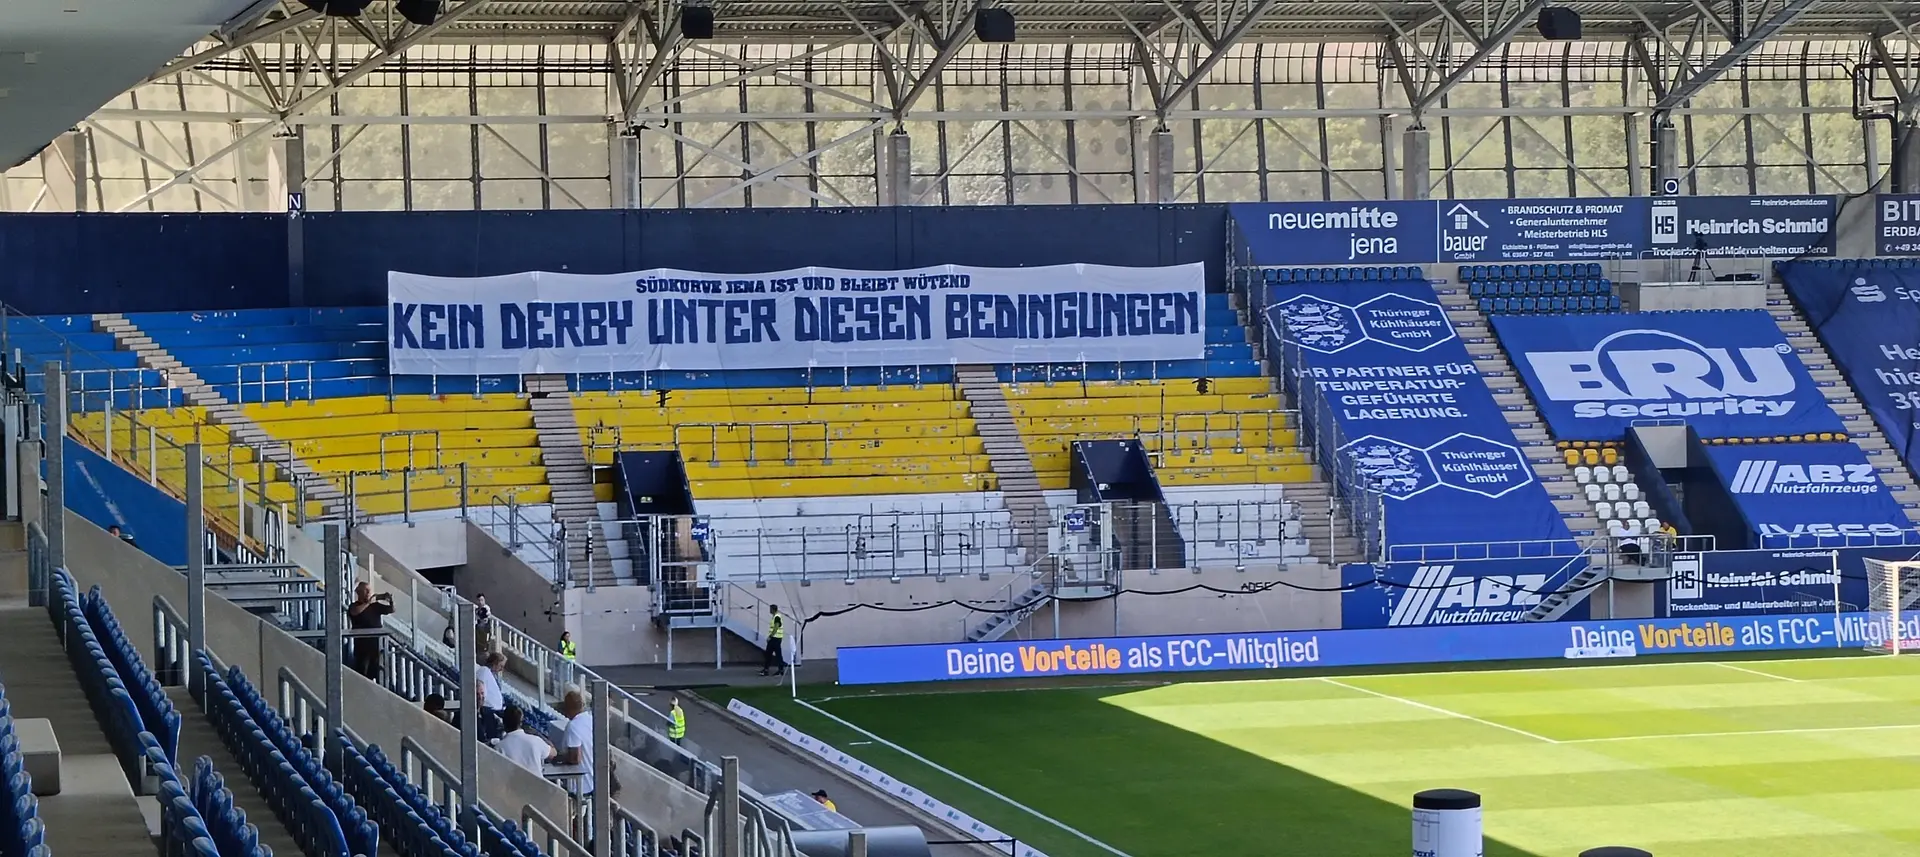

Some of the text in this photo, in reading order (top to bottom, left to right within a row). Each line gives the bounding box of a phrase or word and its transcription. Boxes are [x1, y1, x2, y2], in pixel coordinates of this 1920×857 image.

[289, 194, 301, 209] N
[1507, 205, 1623, 214] BRANDSCHUTZ & PROMAT
[1269, 207, 1398, 229] neuemitte
[1515, 217, 1607, 227] Generalunternehmer
[1655, 215, 1675, 235] HS
[1524, 228, 1608, 239] Meisterbetrieb HLS
[1686, 218, 1828, 235] Heinrich Schmid
[1349, 233, 1397, 260] jena
[1444, 229, 1488, 251] bauer
[1454, 252, 1475, 260] GmbH
[1706, 246, 1724, 256] und
[1788, 247, 1805, 255] aus
[636, 273, 970, 295] SÜDKURVE JENA IST UND BLEIBT WÜTEND
[393, 291, 1199, 351] KEIN DERBY UNTER DIESEN BEDINGUNGEN
[1369, 309, 1431, 319] Thüringer
[1369, 319, 1442, 329] Kühlhäuser
[1391, 329, 1432, 338] GmbH
[1291, 362, 1477, 378] IHR PARTNER FÜR
[1525, 347, 1796, 400] BRU
[1315, 379, 1466, 392] TEMPERATUR-
[1341, 392, 1457, 406] GEFÜHRTE
[1344, 406, 1468, 420] LAGERUNG.
[1573, 397, 1796, 418] Security
[1441, 451, 1507, 460] Thüringer
[1441, 462, 1519, 473] Kühlhäuser
[1773, 464, 1876, 483] ABZ
[1464, 473, 1509, 484] GmbH
[1770, 483, 1878, 494] Nutzfahrzeuge
[1674, 570, 1695, 590] HS
[1706, 571, 1776, 588] Heinrich
[1437, 574, 1546, 608] ABZ
[1671, 602, 1723, 612] Trockenbau-
[1724, 601, 1740, 610] und
[1742, 600, 1799, 609] Malerarbeiten
[1428, 608, 1527, 624] Nutzfahrzeu
[1570, 615, 1920, 649] Deine Vorteile als FCC-Mitglied
[946, 636, 1319, 676] Deine Vorteile als FCC-Mitglied
